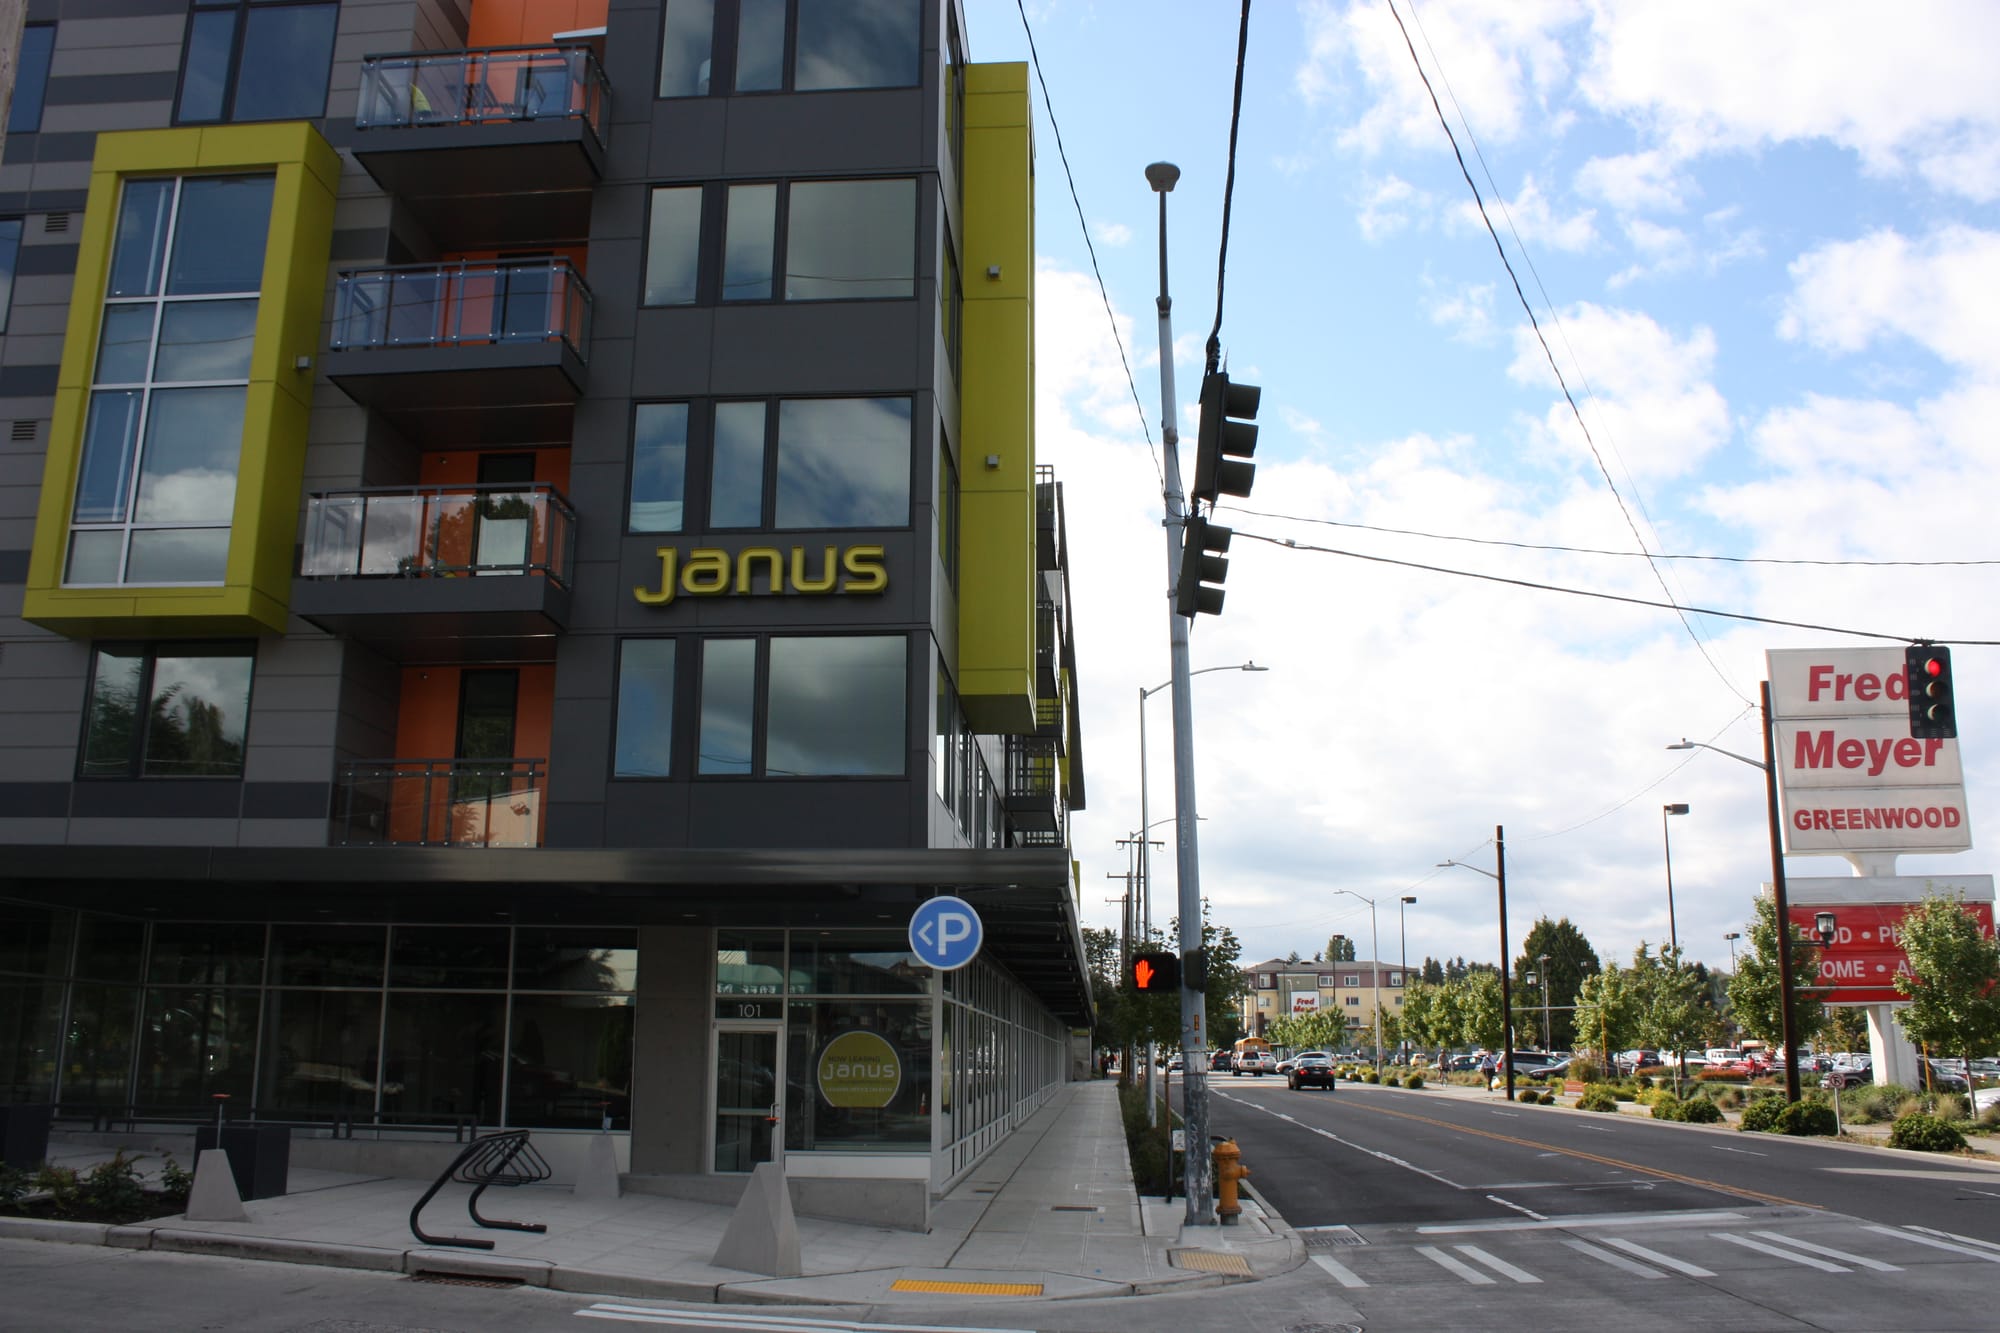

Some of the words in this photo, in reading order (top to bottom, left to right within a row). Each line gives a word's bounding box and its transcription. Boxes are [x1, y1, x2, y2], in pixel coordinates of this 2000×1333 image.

[1808, 664, 1908, 702] Fred
[1794, 730, 1943, 776] Meyer
[1793, 807, 1960, 830] GREENWOOD
[938, 913, 971, 955] P
[739, 1004, 761, 1017] 101
[1296, 997, 1315, 1005] Fred
